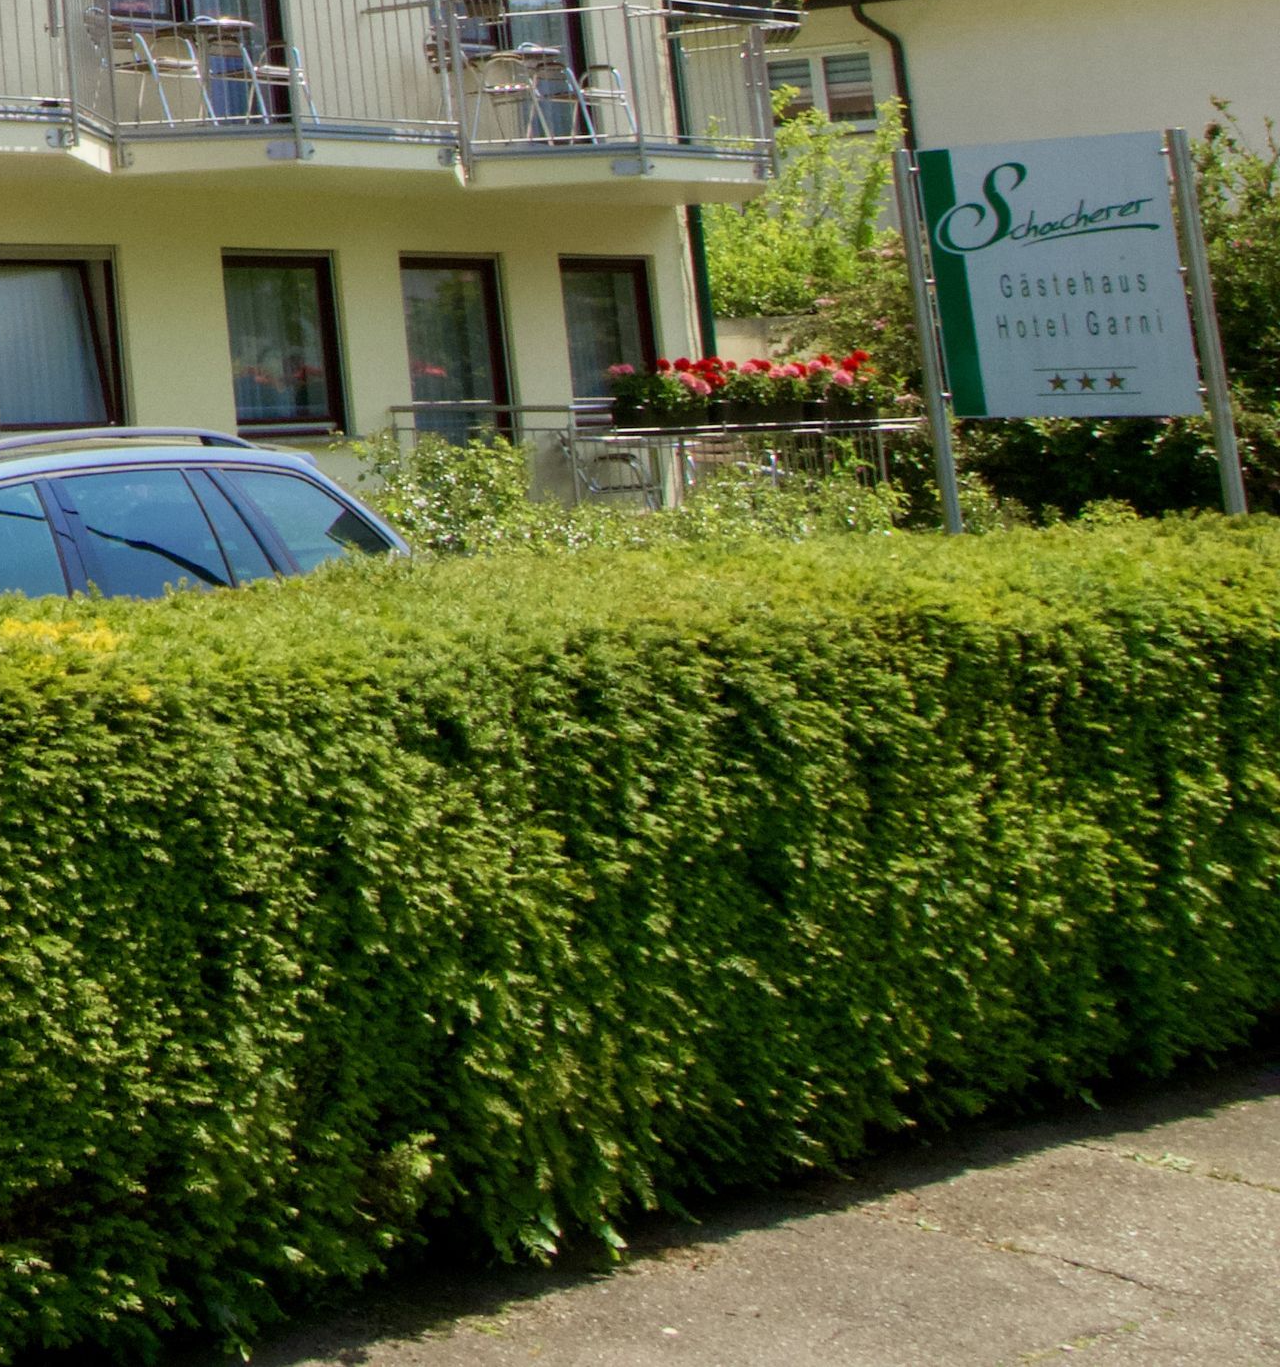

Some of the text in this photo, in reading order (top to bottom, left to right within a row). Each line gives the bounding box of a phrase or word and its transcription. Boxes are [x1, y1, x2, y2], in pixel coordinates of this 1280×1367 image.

[938, 161, 1154, 253] Schacherer
[999, 270, 1148, 299] Gästehaus
[996, 309, 1164, 339] Hotel Garni
